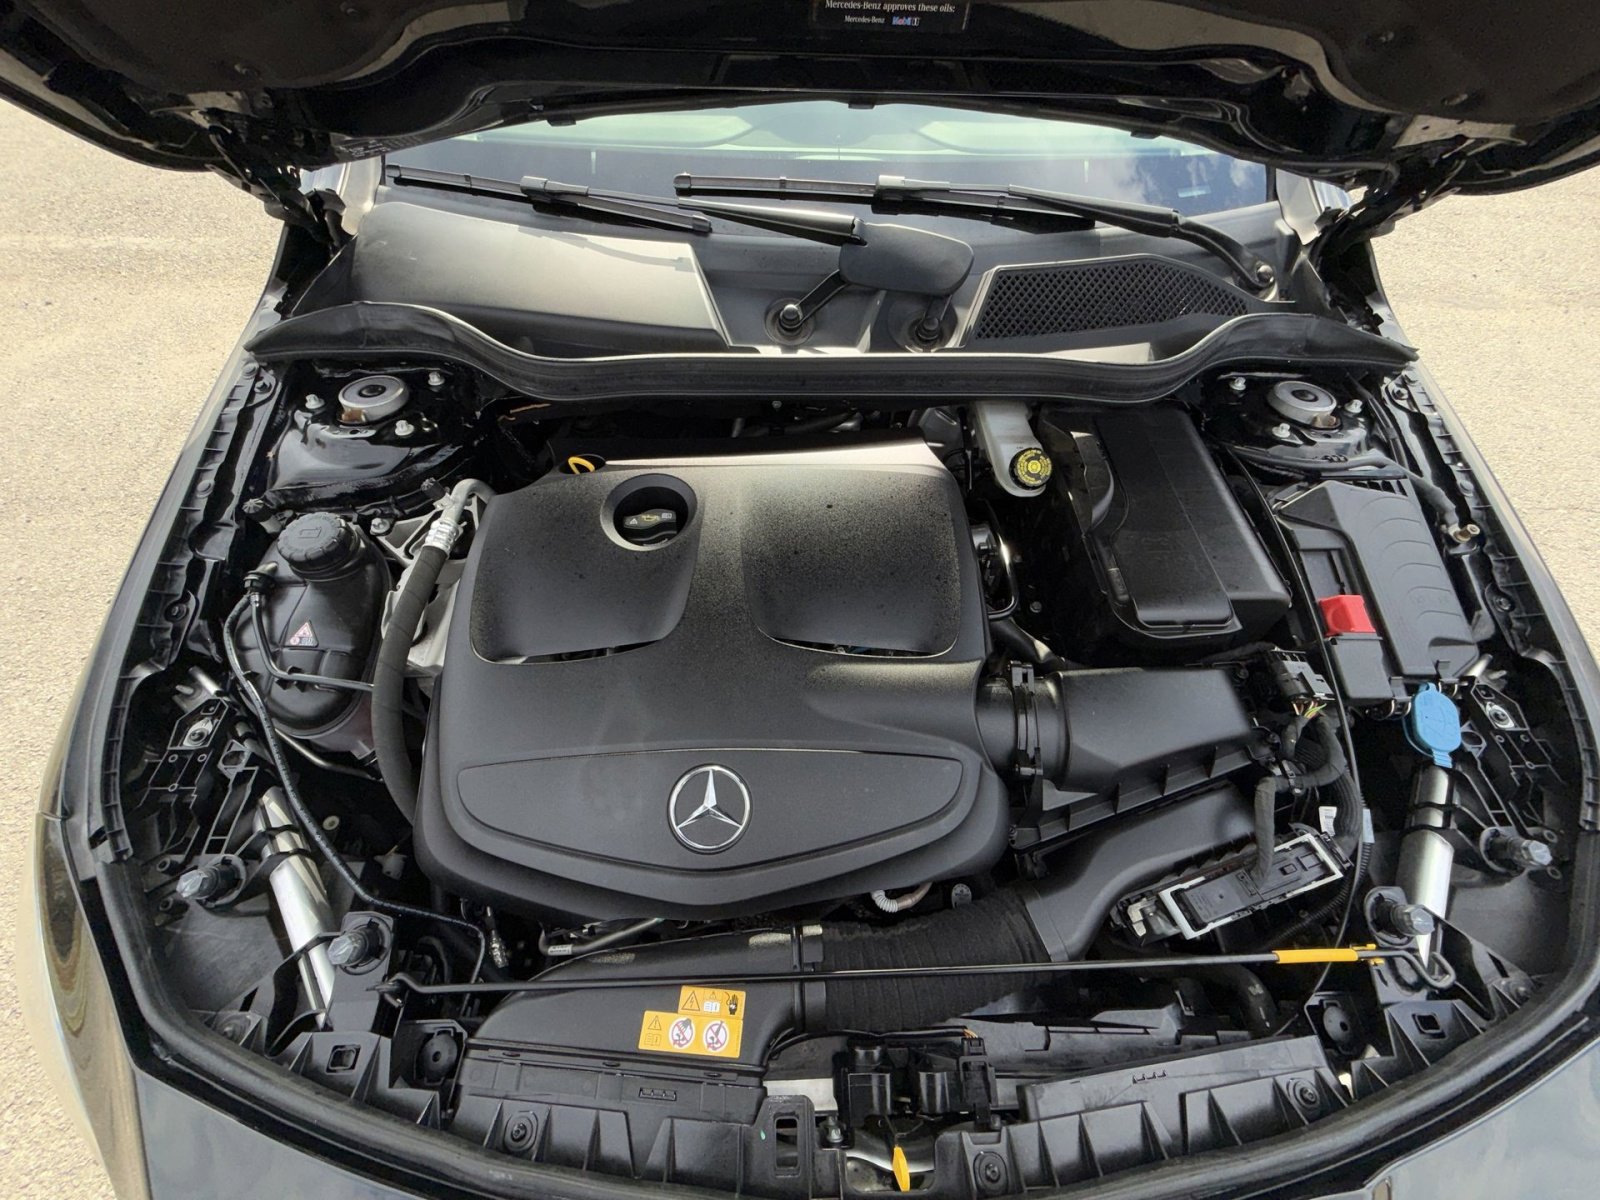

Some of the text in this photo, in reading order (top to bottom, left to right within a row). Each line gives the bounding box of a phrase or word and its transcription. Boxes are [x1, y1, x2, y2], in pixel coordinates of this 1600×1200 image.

[825, 0, 956, 13] Mercedes-Benz approves these oils:
[844, 15, 886, 24] Mercedes-Benz
[892, 16, 912, 26] Mobil
